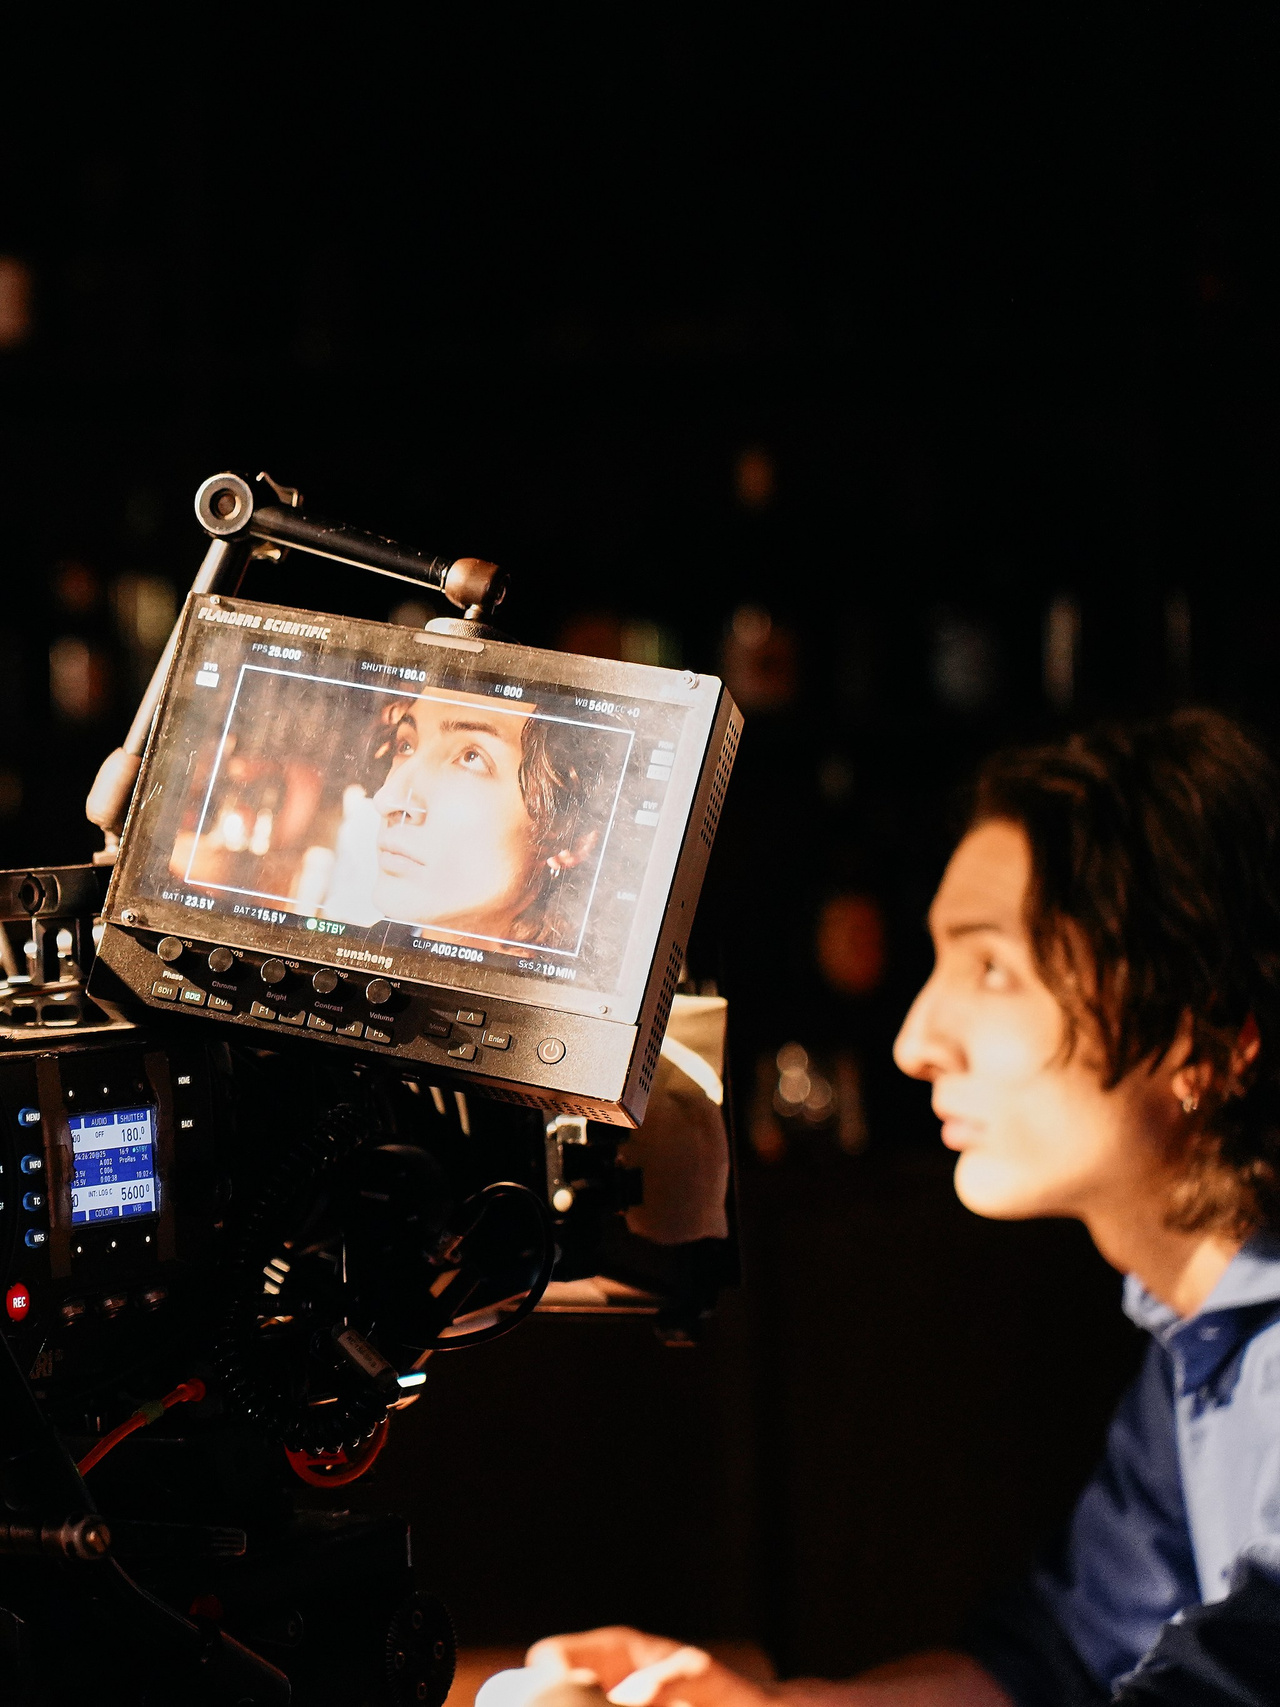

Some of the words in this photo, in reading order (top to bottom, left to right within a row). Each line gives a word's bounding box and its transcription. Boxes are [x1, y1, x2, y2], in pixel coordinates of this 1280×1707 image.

[197, 607, 262, 629] FLANDERS
[262, 618, 331, 641] SCIENTIFIC
[252, 643, 268, 654] FPS
[267, 646, 302, 661] 25.000
[360, 661, 398, 676] SHUTTER
[398, 667, 426, 682] 180.0
[503, 685, 523, 699] 800
[575, 696, 588, 708] WB
[588, 699, 614, 714] 5600
[162, 891, 179, 901] BAT
[234, 904, 250, 915] BAT
[318, 922, 346, 936] STBY
[412, 940, 432, 950] CLIP
[162, 970, 184, 981] Phase
[157, 986, 173, 995] SDI1
[211, 980, 238, 992] Chroma
[184, 991, 201, 1001] SDI2
[266, 991, 288, 1002] Bright
[258, 1006, 270, 1015] F1
[314, 1001, 344, 1012] Contrast
[316, 1018, 326, 1027] F3
[370, 1012, 395, 1023] Volume
[488, 1034, 506, 1044] Enter
[26, 1112, 40, 1122] MENU
[91, 1118, 108, 1126] AUDIO
[120, 1112, 144, 1123] SHUTTER
[94, 1130, 105, 1138] OFF
[29, 1160, 42, 1169] INFO
[75, 1170, 86, 1178] 3.5V
[33, 1197, 41, 1206] TC
[94, 1208, 114, 1218] COLOR
[132, 1203, 142, 1212] WB
[12, 1296, 26, 1309] REC
